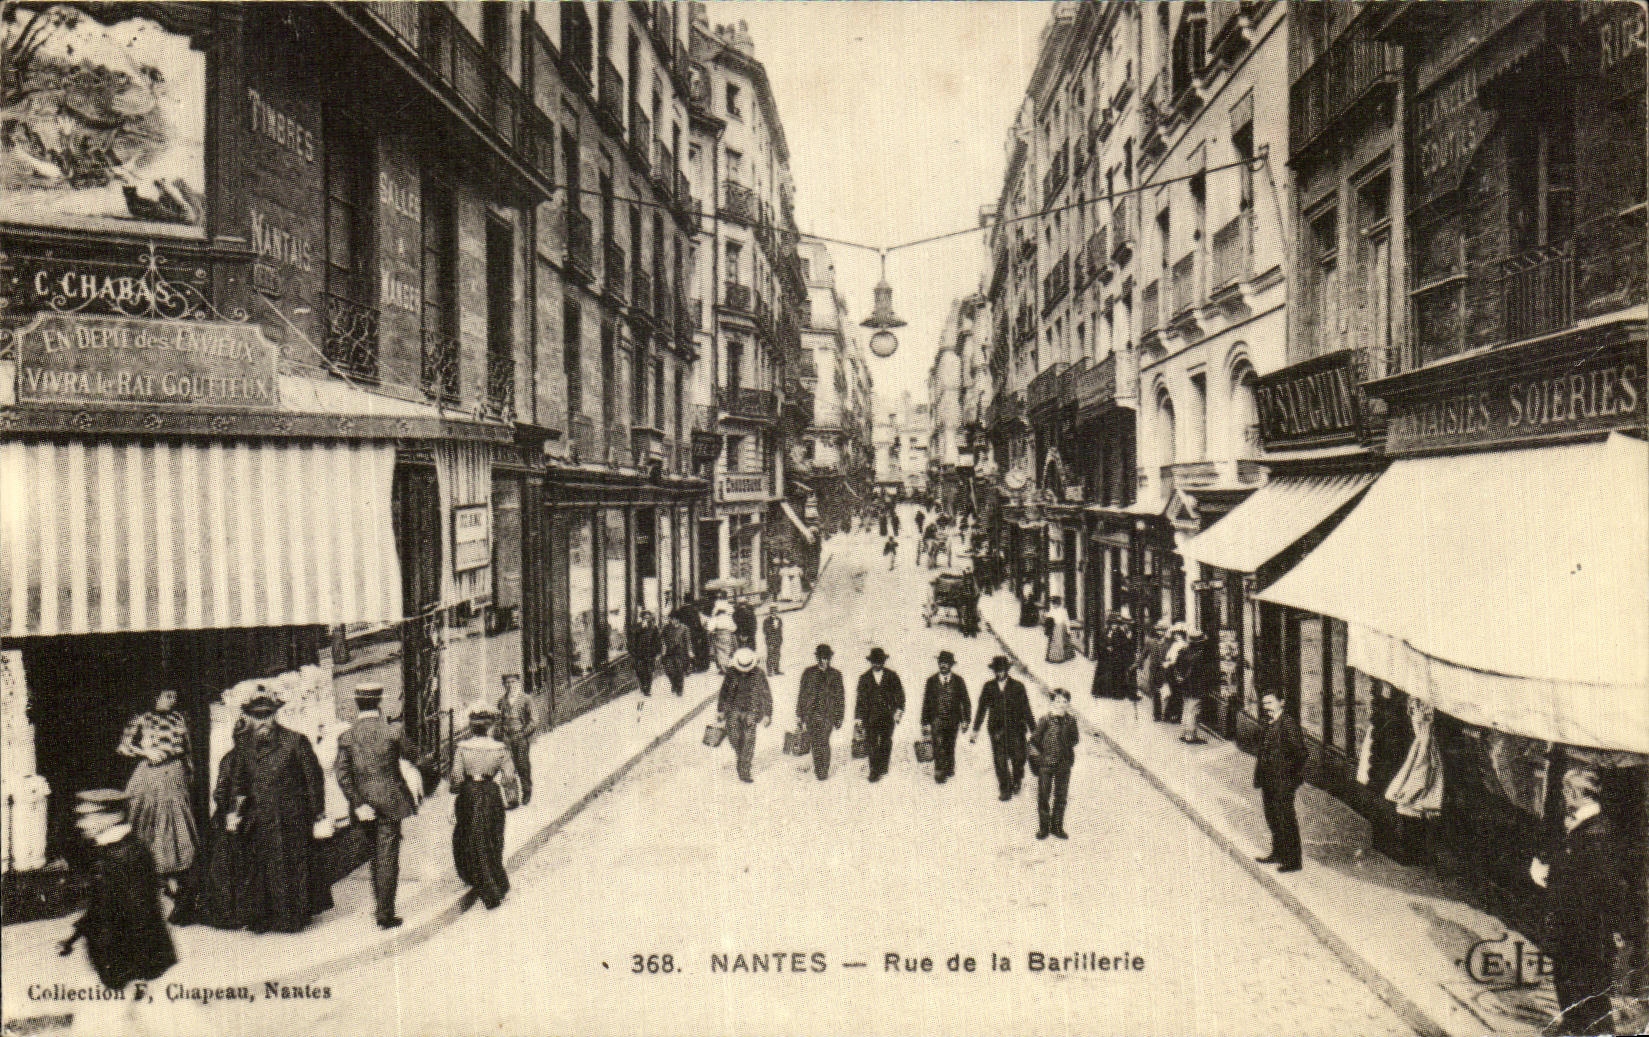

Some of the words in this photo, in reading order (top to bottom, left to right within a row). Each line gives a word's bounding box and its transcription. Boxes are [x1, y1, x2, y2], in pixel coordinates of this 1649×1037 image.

[248, 87, 314, 163] TIMBRES
[250, 209, 311, 272] NANTAIS
[60, 271, 172, 302] CHABAS
[43, 328, 70, 352] EN
[134, 328, 170, 350] des
[175, 327, 253, 362] ENVIEUX
[26, 367, 90, 393] VIVRA
[97, 369, 113, 394] le
[117, 370, 152, 396] RAT
[161, 370, 269, 399] GOUTTEUX
[1507, 364, 1639, 428] SOIERIES
